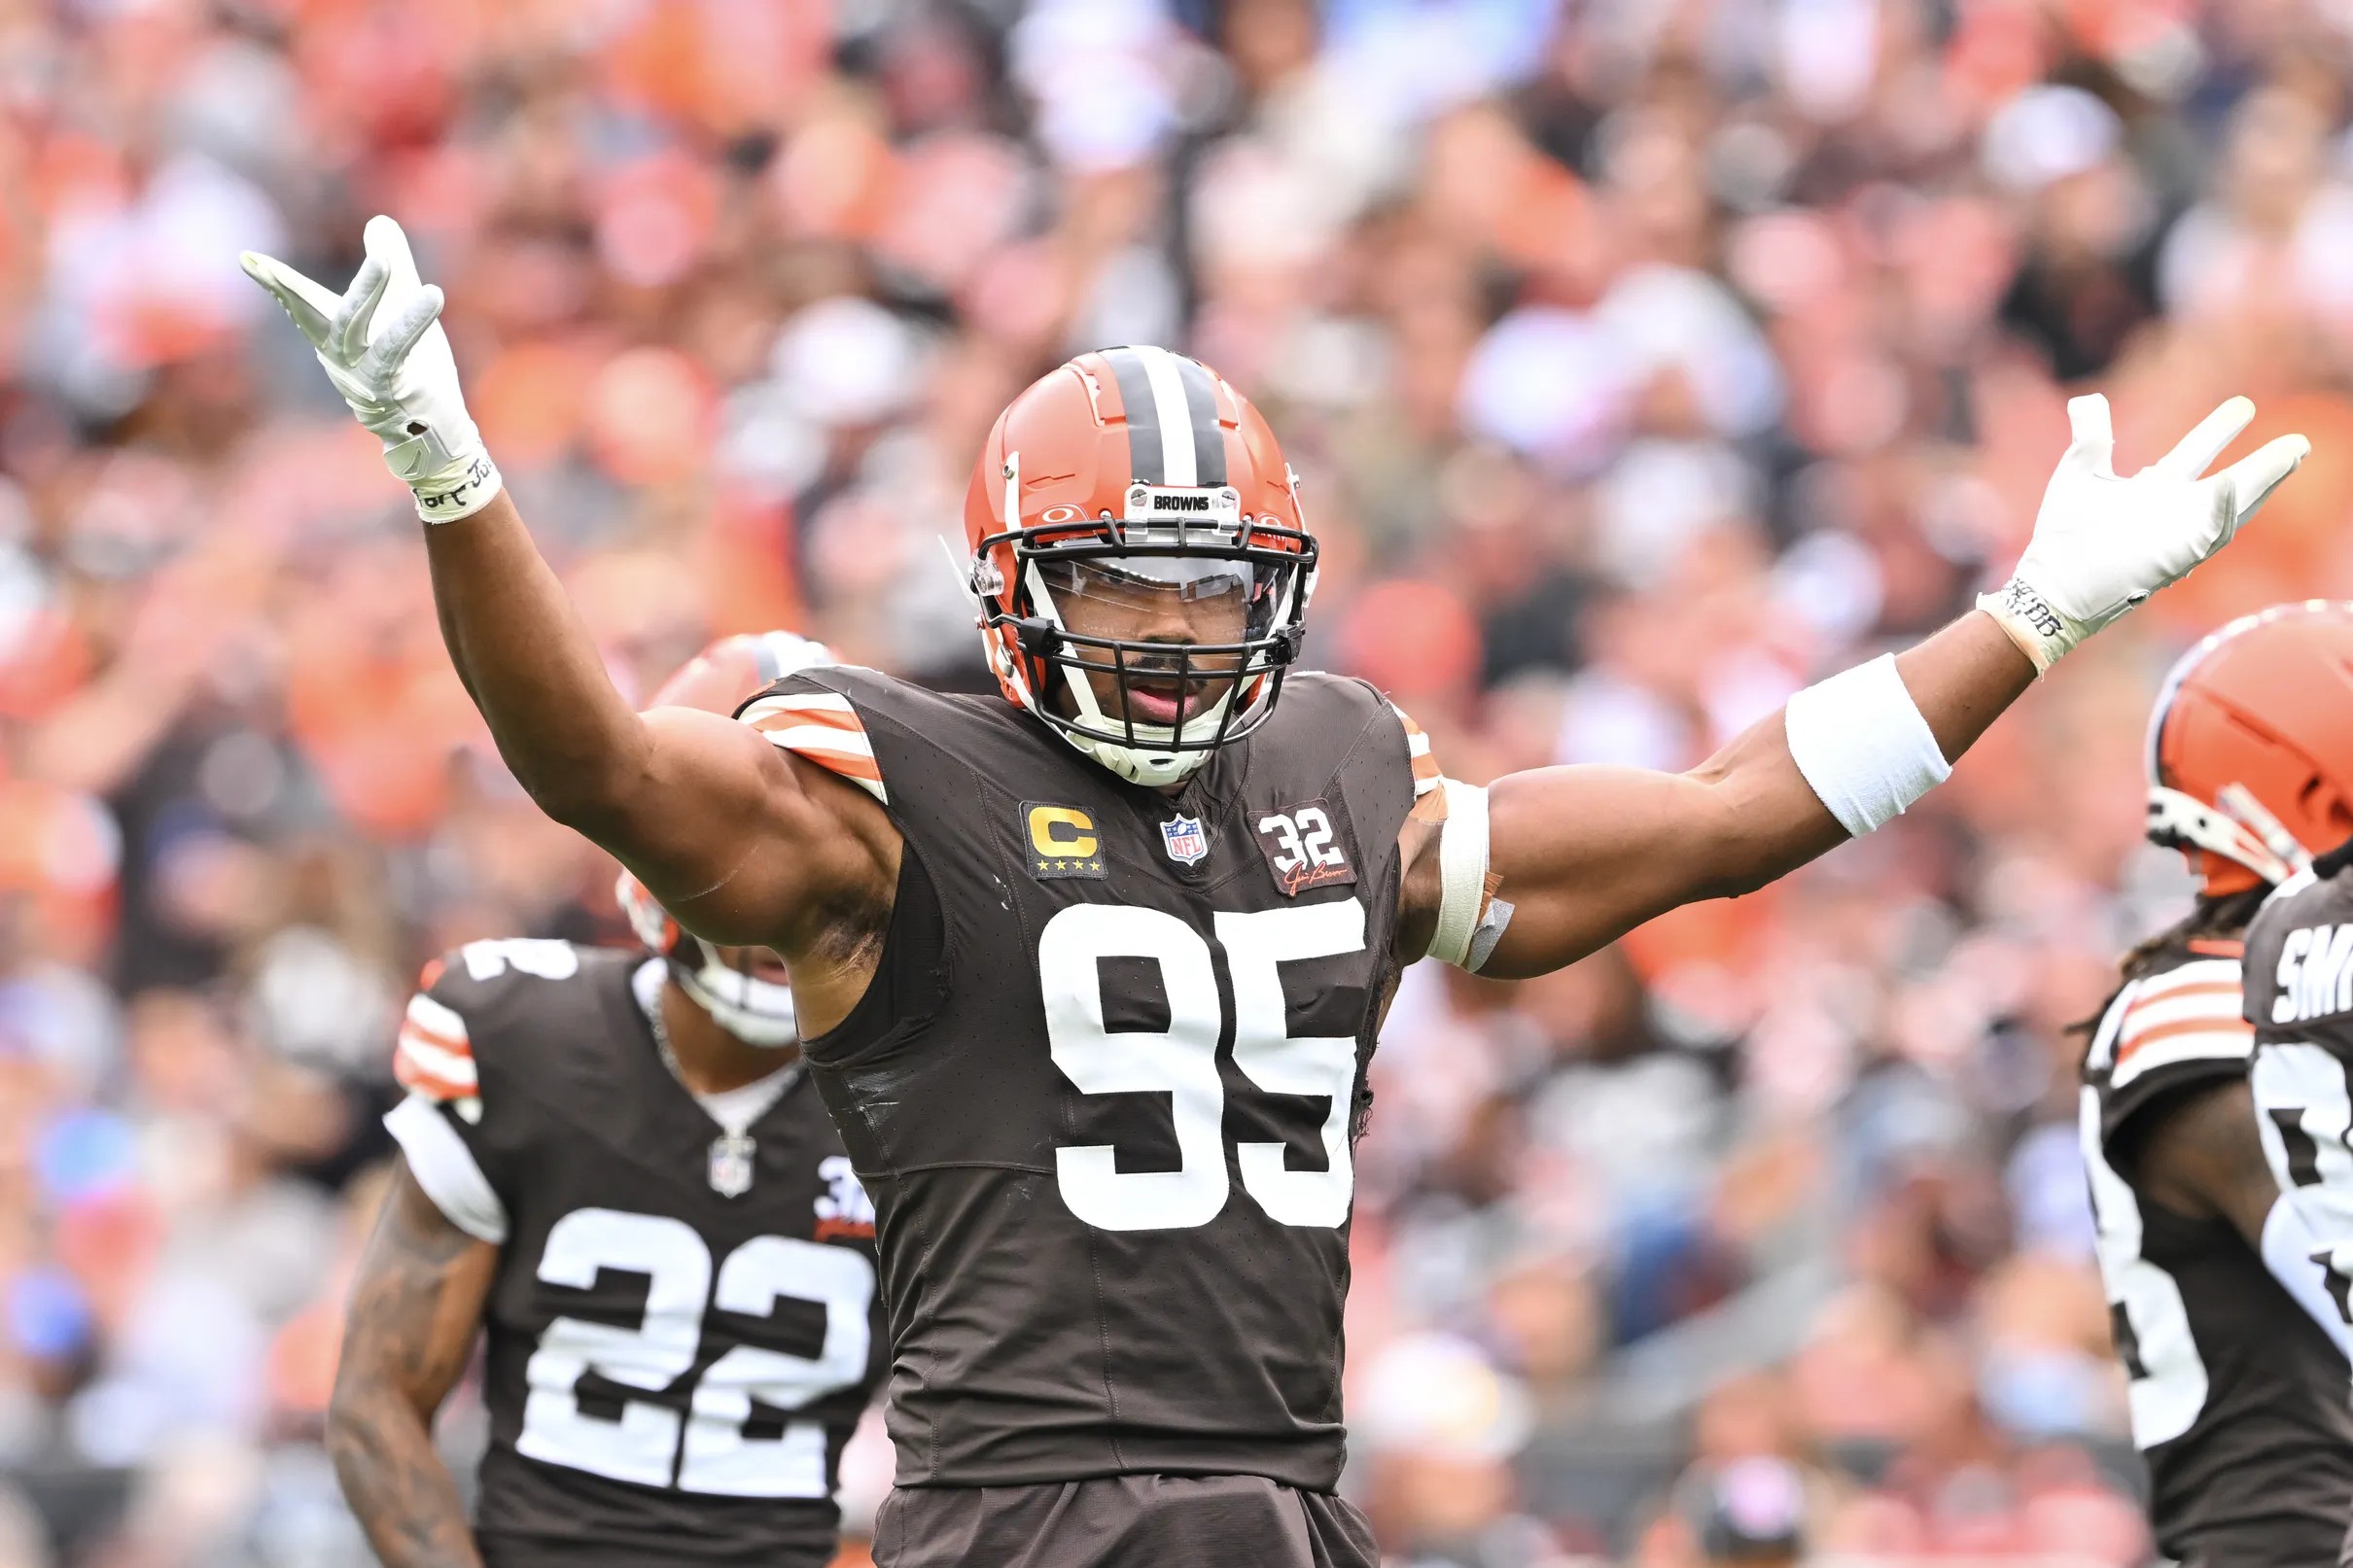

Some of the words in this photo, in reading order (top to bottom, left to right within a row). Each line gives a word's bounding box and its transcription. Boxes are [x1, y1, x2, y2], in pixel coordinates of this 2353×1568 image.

[1153, 495, 1210, 511] BROWNS
[1029, 807, 1097, 857] C
[1172, 836, 1201, 855] NFL
[1258, 807, 1345, 873] 32
[1038, 896, 1365, 1232] 95
[517, 1207, 873, 1498] 22
